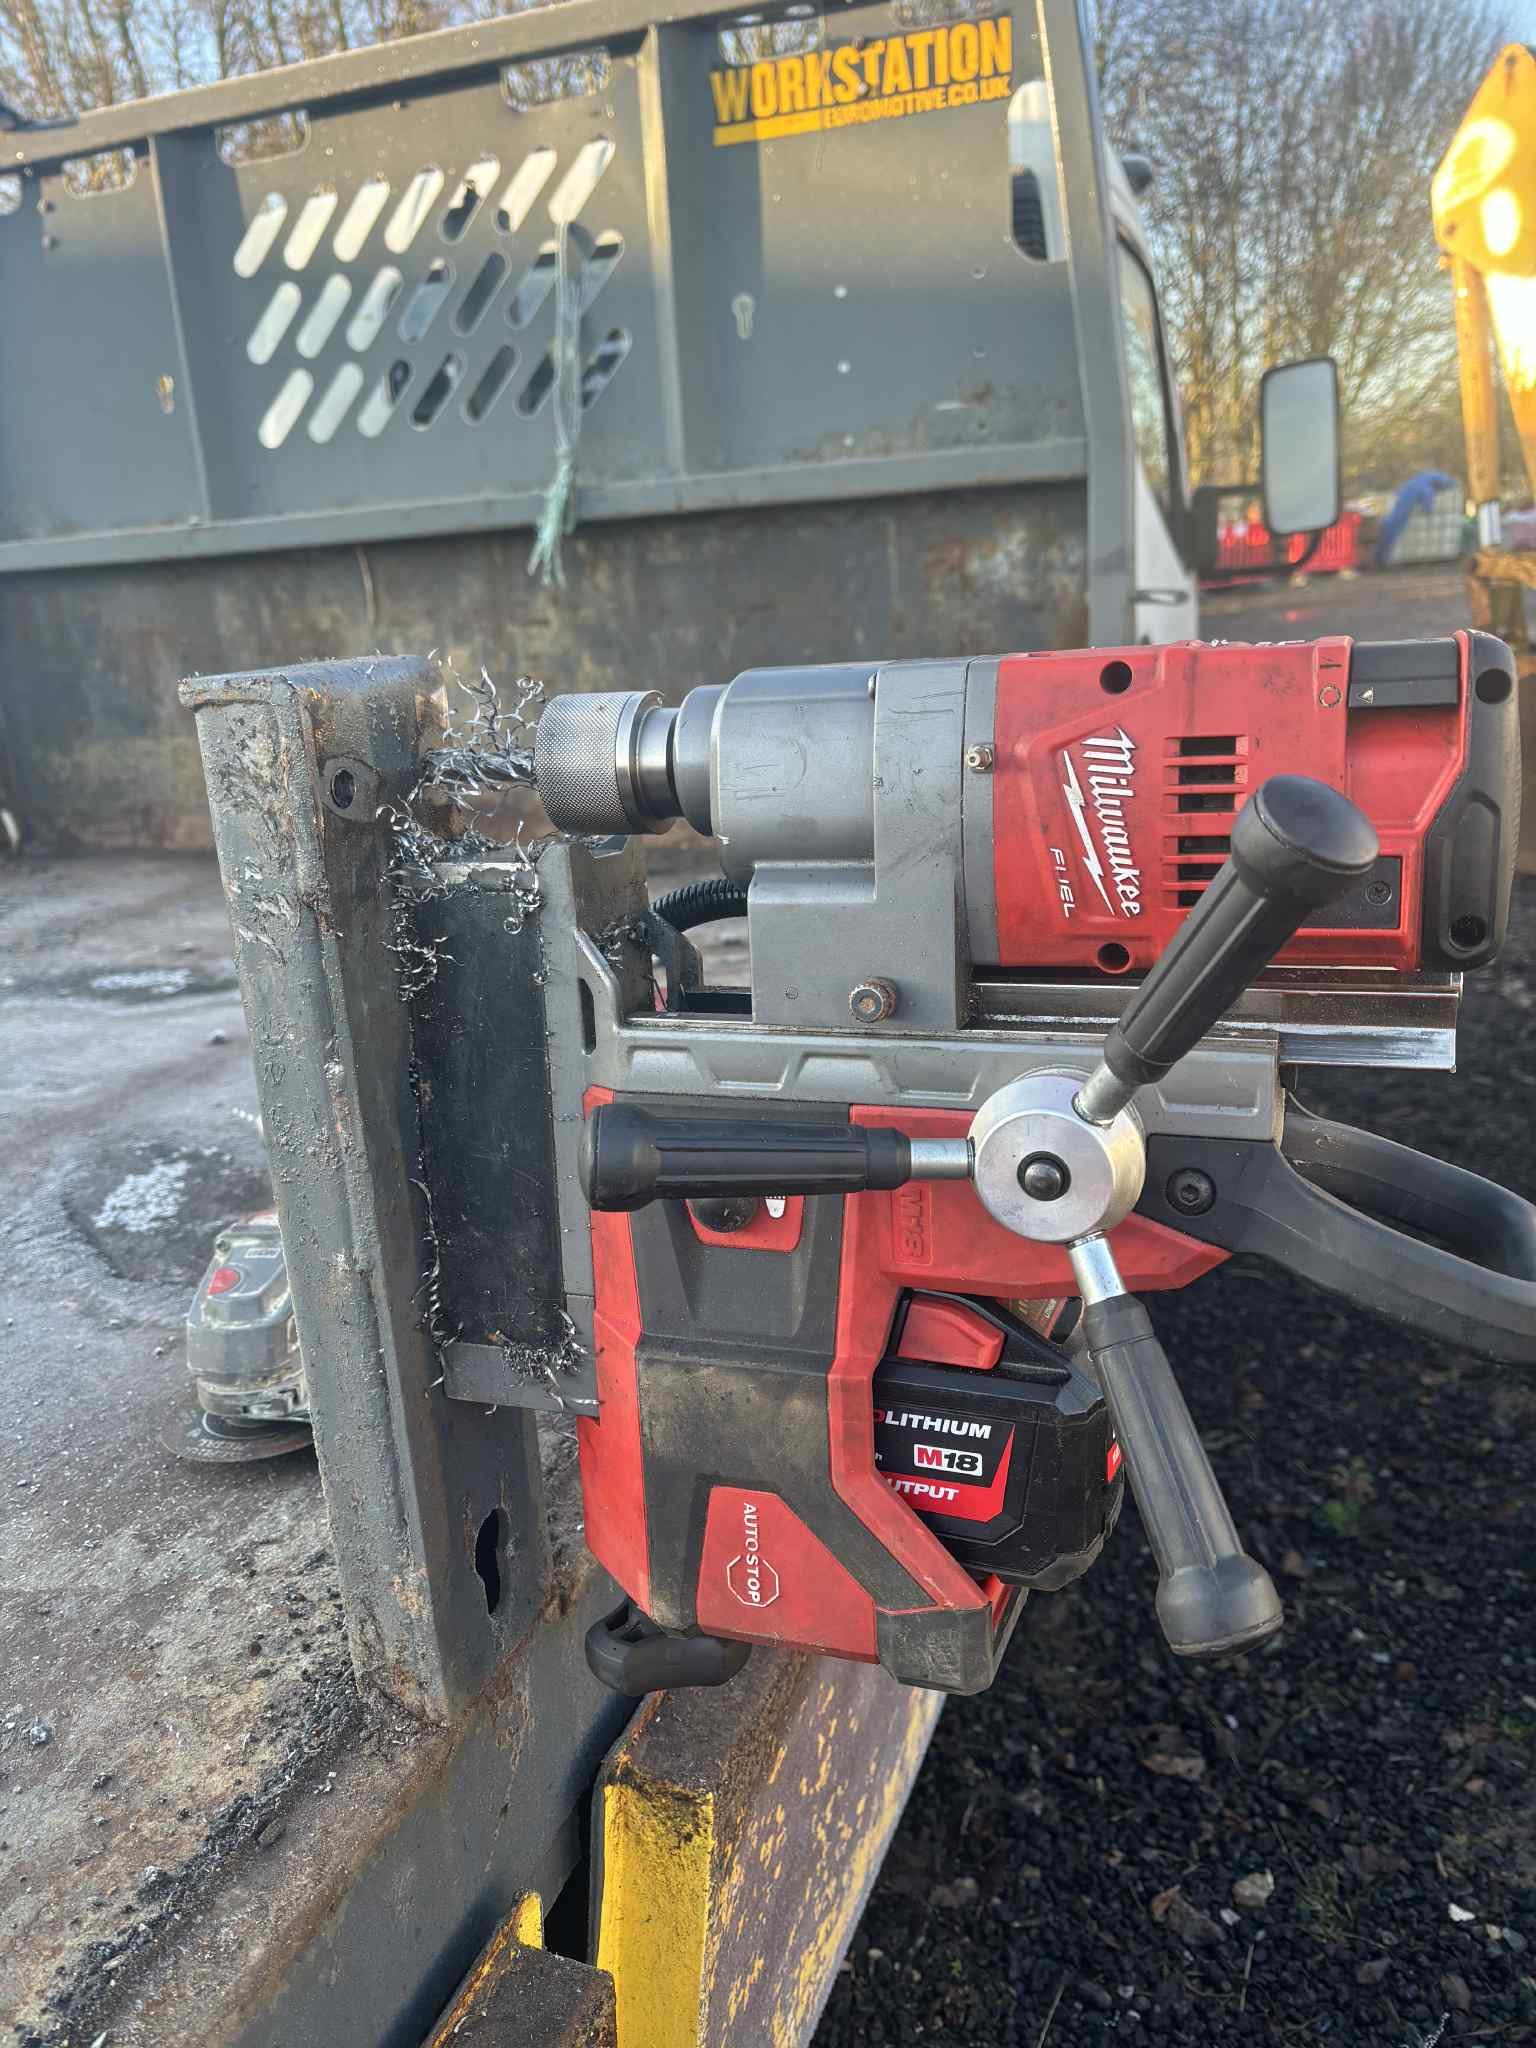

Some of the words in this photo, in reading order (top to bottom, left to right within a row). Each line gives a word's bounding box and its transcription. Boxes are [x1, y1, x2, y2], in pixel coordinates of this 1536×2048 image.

[710, 16, 1012, 124] WORKSTATION
[1081, 725, 1141, 918] Milwaukee
[1050, 847, 1076, 919] FUEL
[888, 1478, 960, 1501] UTPUT
[916, 1446, 979, 1473] M18
